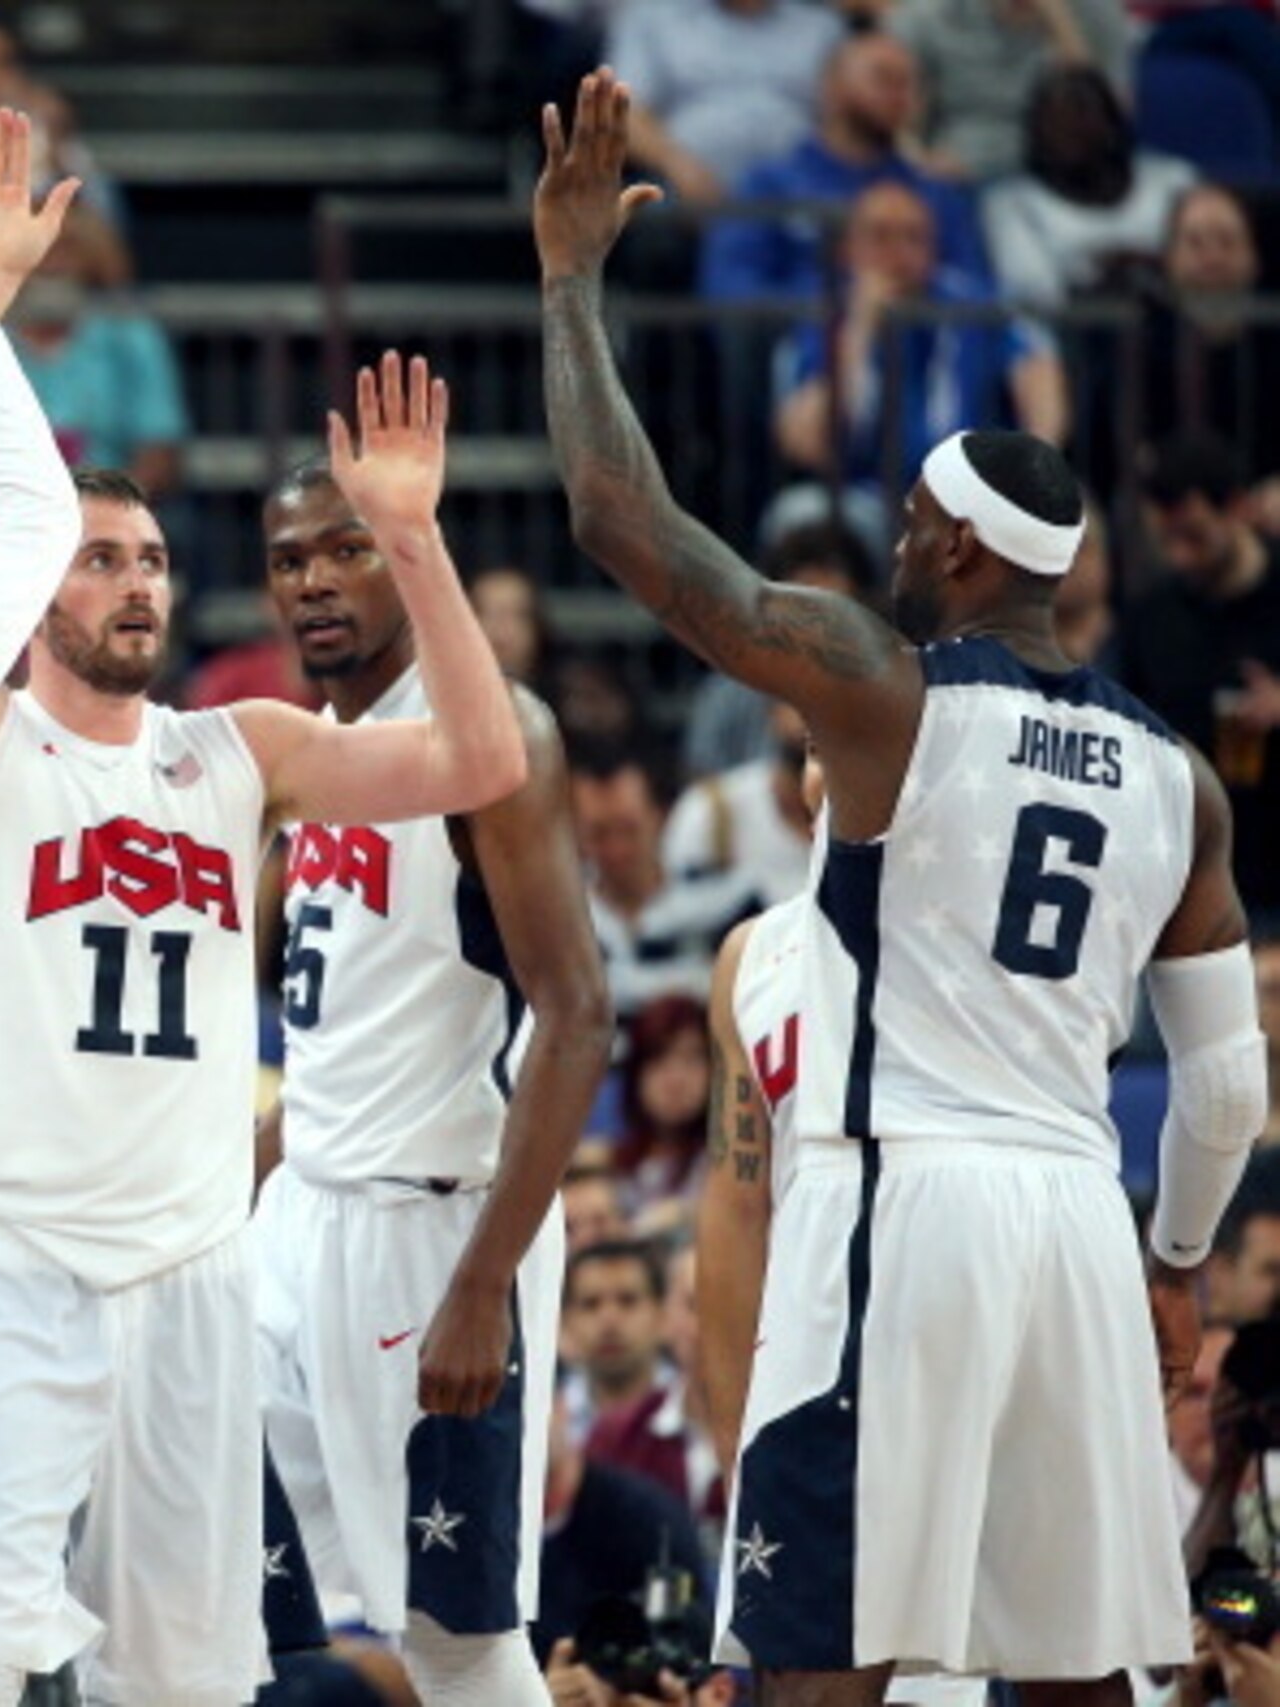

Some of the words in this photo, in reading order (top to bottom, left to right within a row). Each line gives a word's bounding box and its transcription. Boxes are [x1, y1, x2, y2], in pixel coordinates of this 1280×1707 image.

[1007, 714, 1122, 790] JAMES
[26, 814, 241, 933] USA
[284, 821, 392, 918] SA
[990, 802, 1109, 981] 6
[74, 923, 199, 1061] 11
